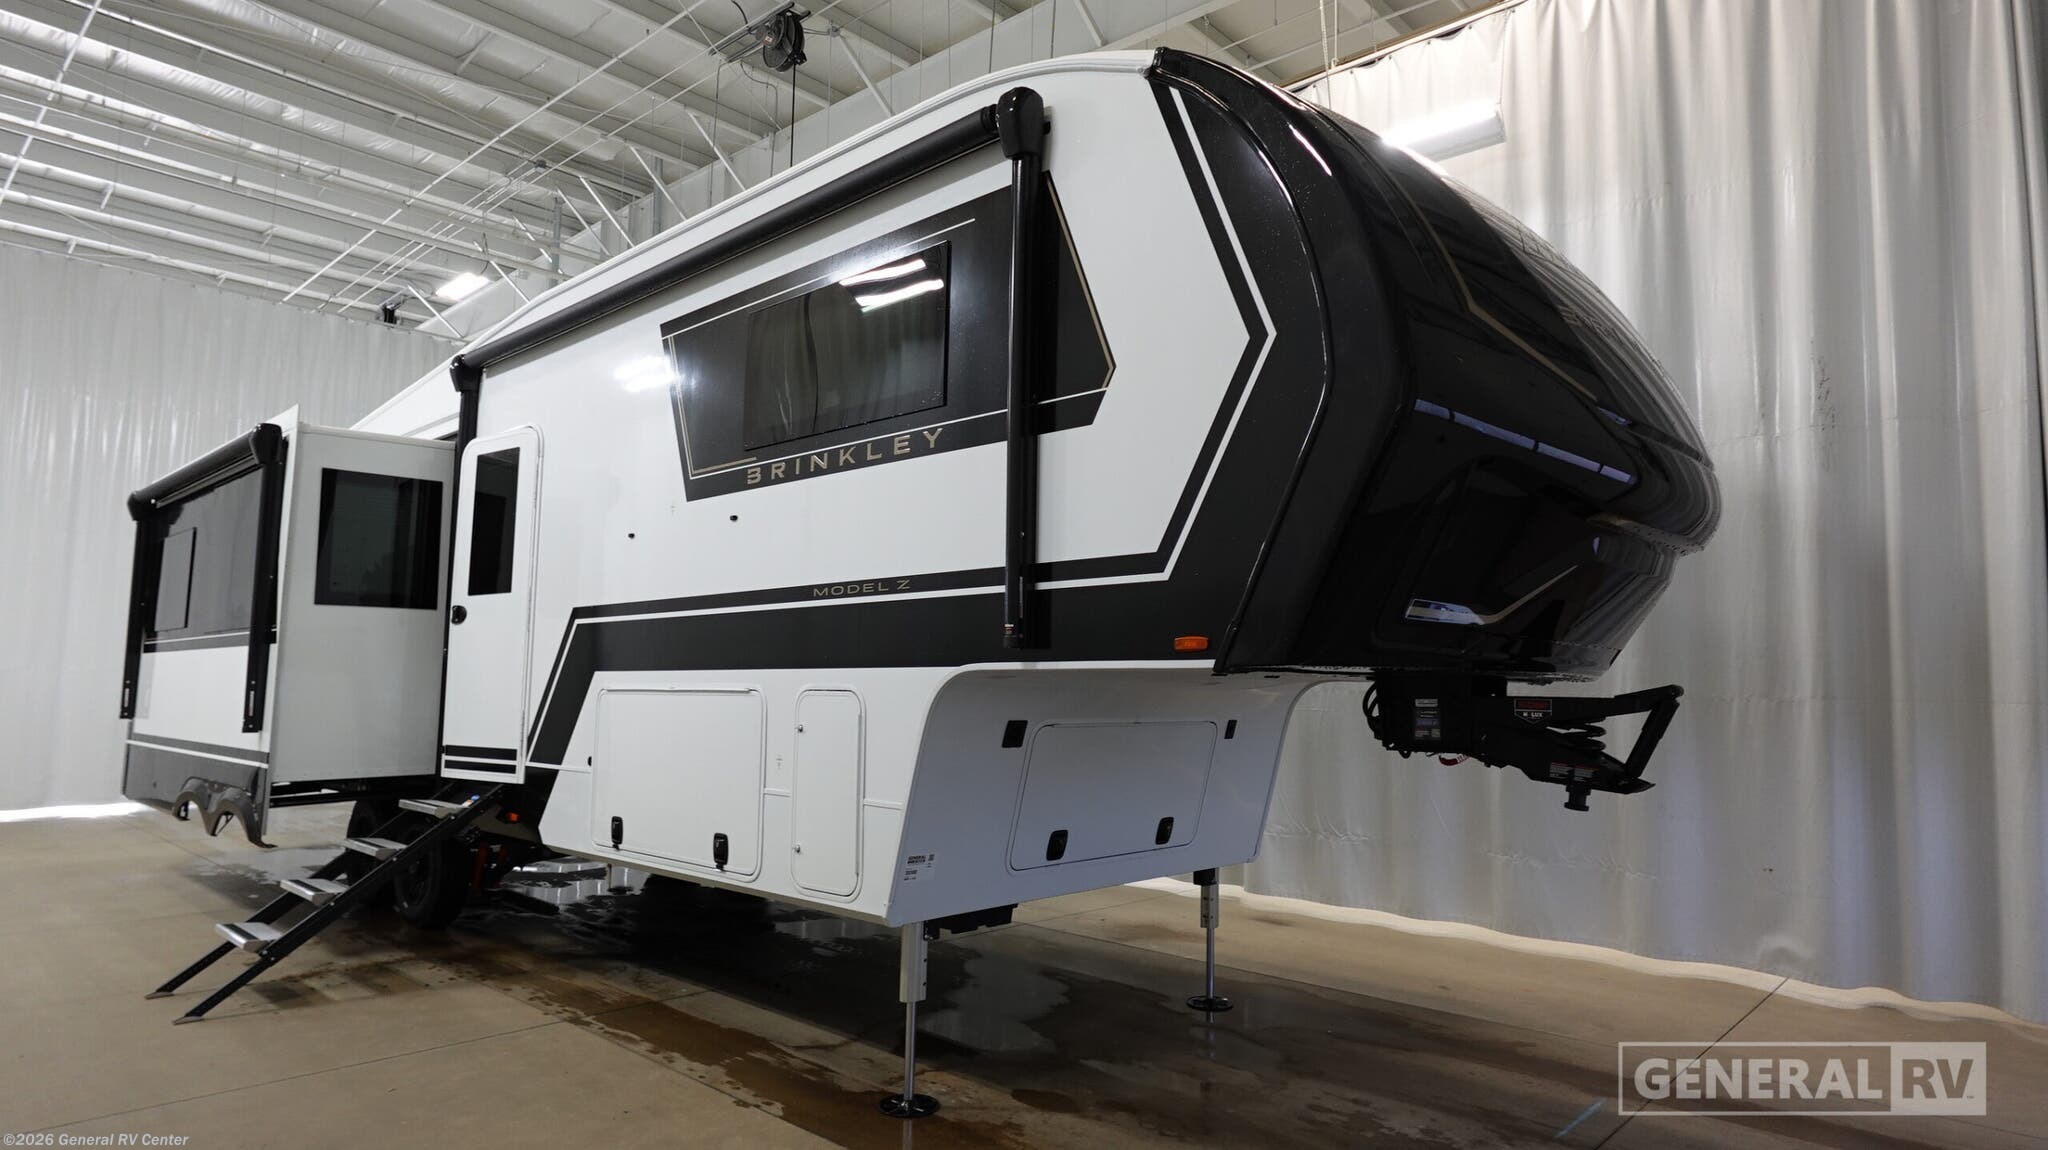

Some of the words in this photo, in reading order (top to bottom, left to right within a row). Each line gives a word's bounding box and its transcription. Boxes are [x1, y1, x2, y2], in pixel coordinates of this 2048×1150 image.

[747, 428, 943, 484] BRINKLEY
[813, 583, 889, 597] MODEL
[896, 580, 911, 590] Z
